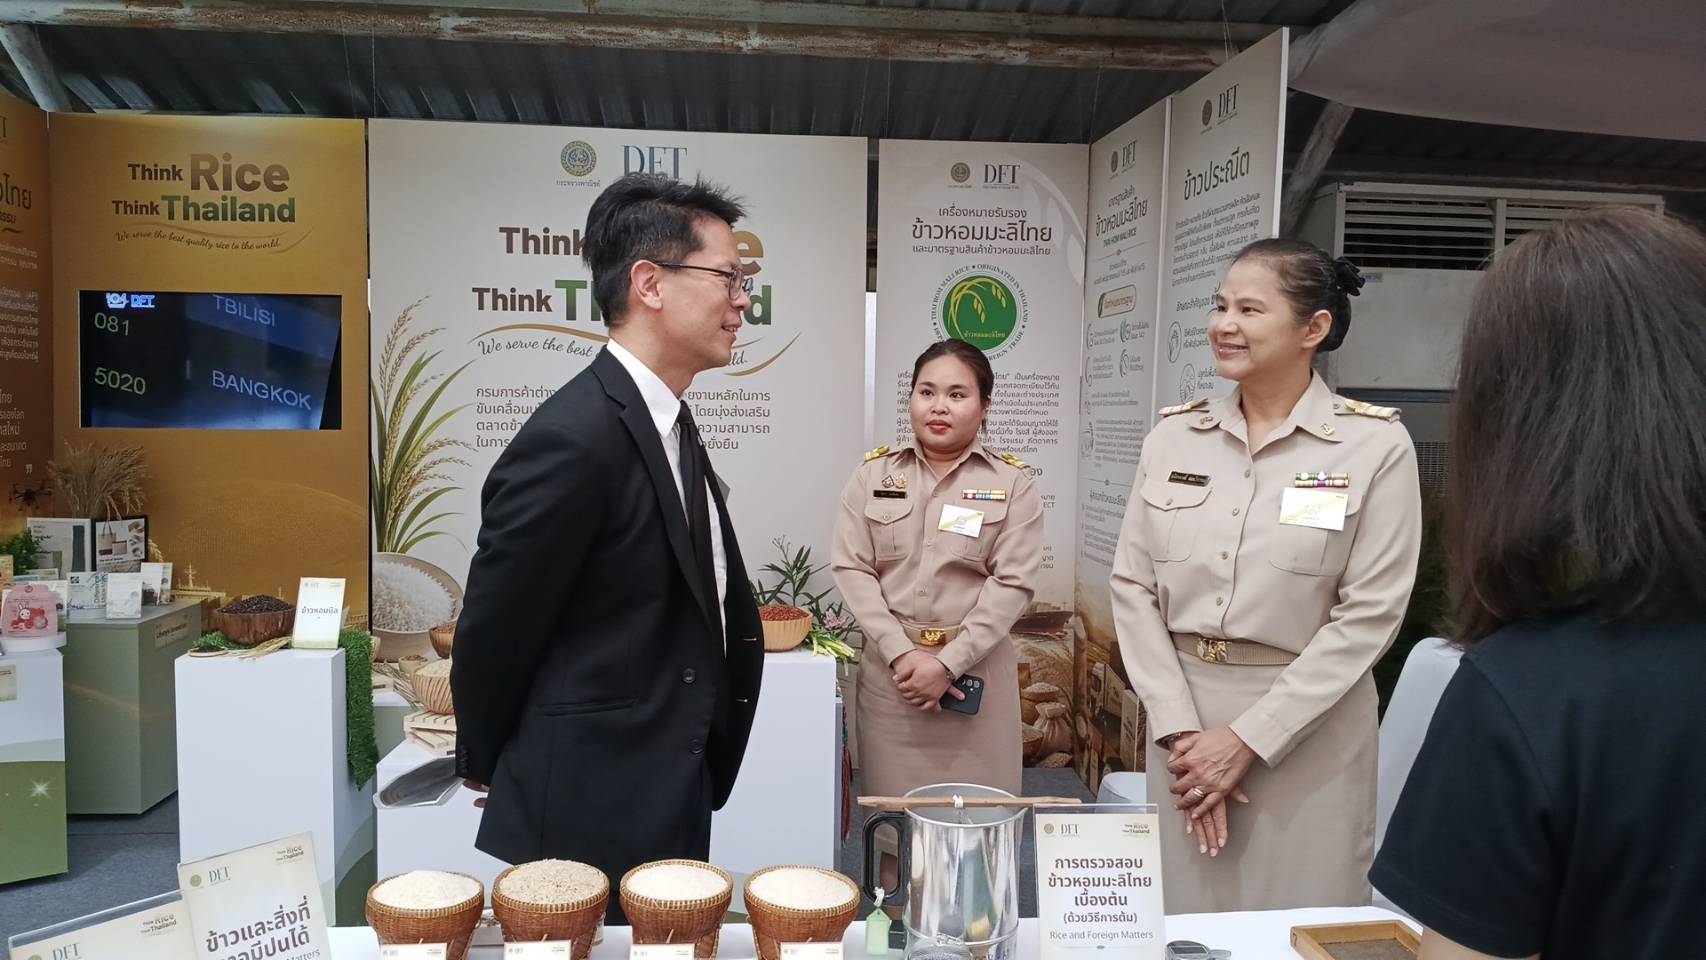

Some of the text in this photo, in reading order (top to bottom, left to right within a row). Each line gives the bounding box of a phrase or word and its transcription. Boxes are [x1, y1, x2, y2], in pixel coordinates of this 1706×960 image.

[1219, 84, 1239, 119] DFT
[128, 152, 289, 192] Think Rice
[984, 164, 1020, 183] DFT
[1184, 146, 1250, 200] ข้าวประณีต
[112, 195, 296, 223] Think Thailand
[939, 203, 1027, 218] เครื่องหมายรับรอง
[912, 217, 1052, 241] ข้าวหอมมะลิไทย
[499, 227, 585, 256] Think
[212, 294, 275, 327] TBILISI
[472, 287, 552, 312] Think
[94, 312, 130, 336] 081
[478, 337, 593, 357] We serve the best
[94, 367, 146, 395] 5020
[212, 370, 312, 410] BANGKOK
[476, 385, 556, 398] กรมการค้าต่าง
[695, 405, 770, 419] โดยมุ่งส่งเสริม
[476, 419, 524, 431] ตลาดข้า
[1055, 858, 1143, 869] การตรวจสอบ
[1048, 872, 1152, 888] ข้าวหอมมะลิไทย
[1074, 888, 1128, 906] เบื้องต้น
[206, 895, 311, 952] ข้าวและสิ่งที่
[1063, 911, 1138, 924] (ด้วยวิธีการต้ม)
[1050, 930, 1154, 941] Rice and Foreign Matters
